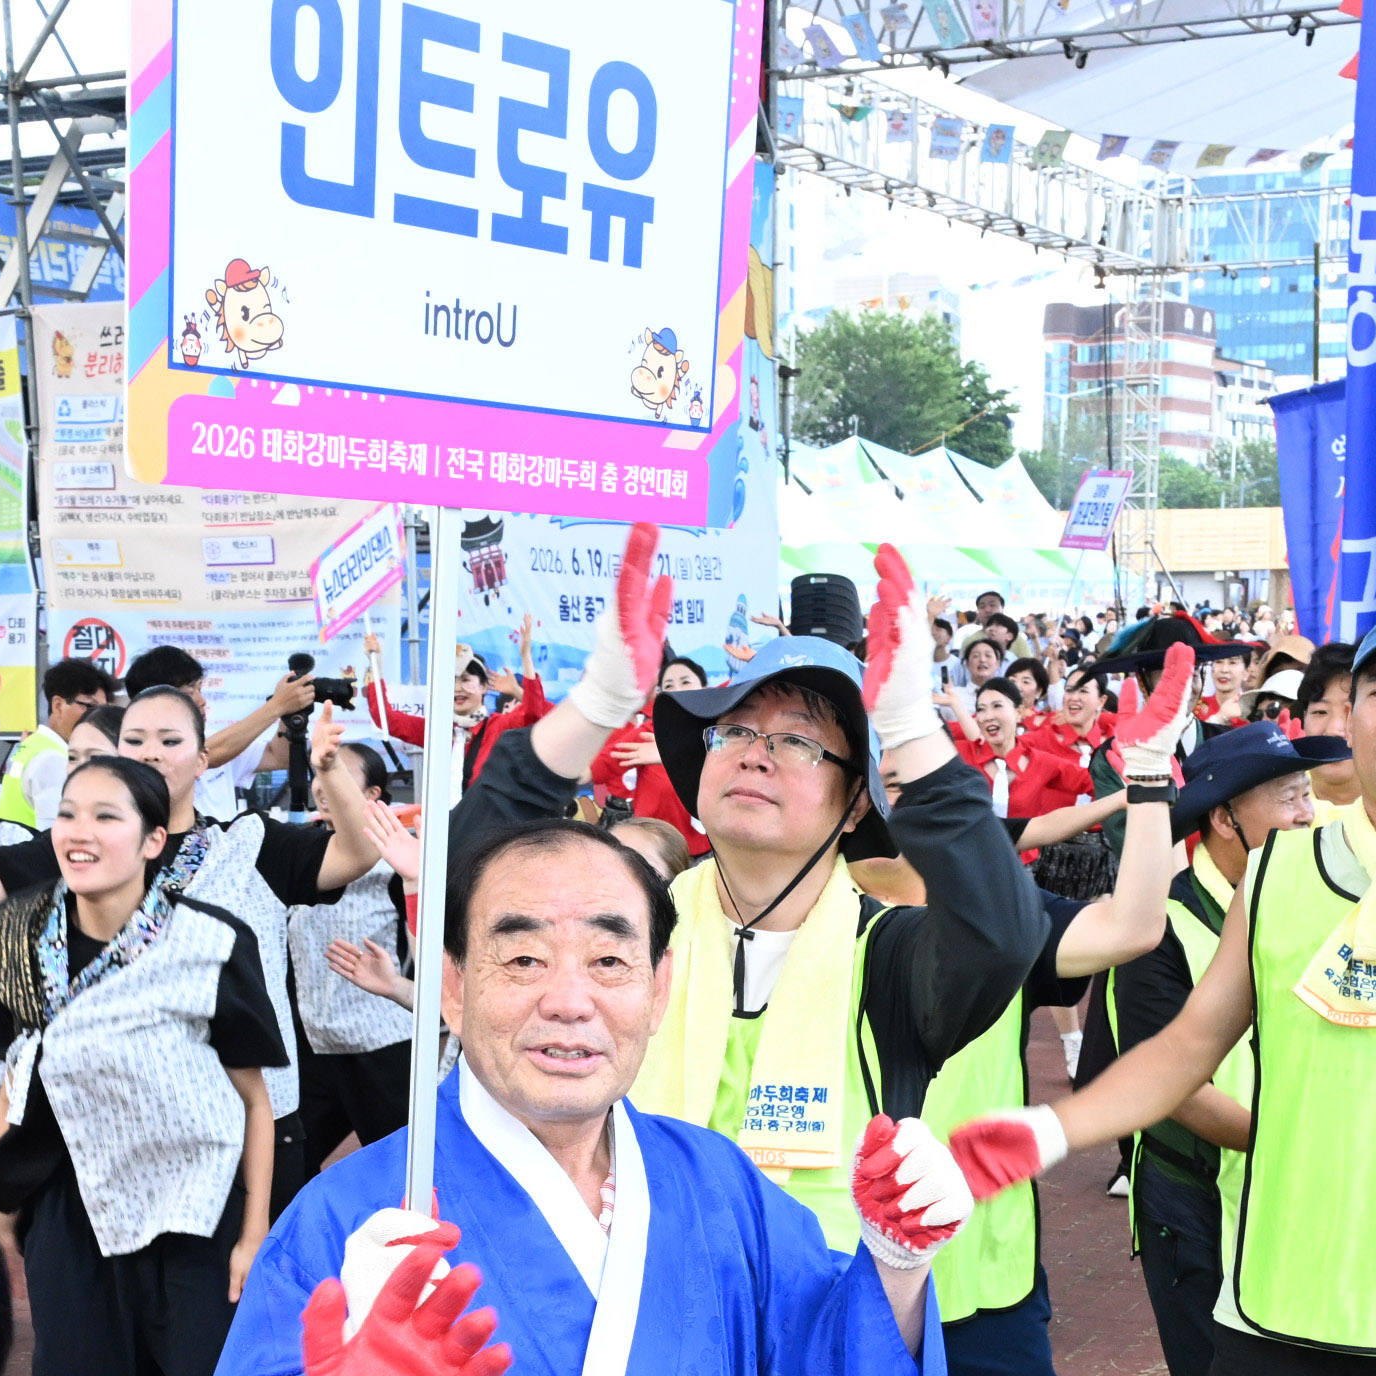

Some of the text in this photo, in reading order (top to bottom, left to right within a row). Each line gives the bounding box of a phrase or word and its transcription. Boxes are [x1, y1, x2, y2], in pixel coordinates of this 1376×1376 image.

[270, 0, 658, 268] 인트로유
[424, 290, 517, 348] introU
[191, 422, 689, 500] 2026 태화강마두희축제 전국 태화강마두희 춤 경연대회
[695, 555, 723, 582] 3일간
[558, 595, 581, 623] 울산
[72, 625, 115, 650] 절대
